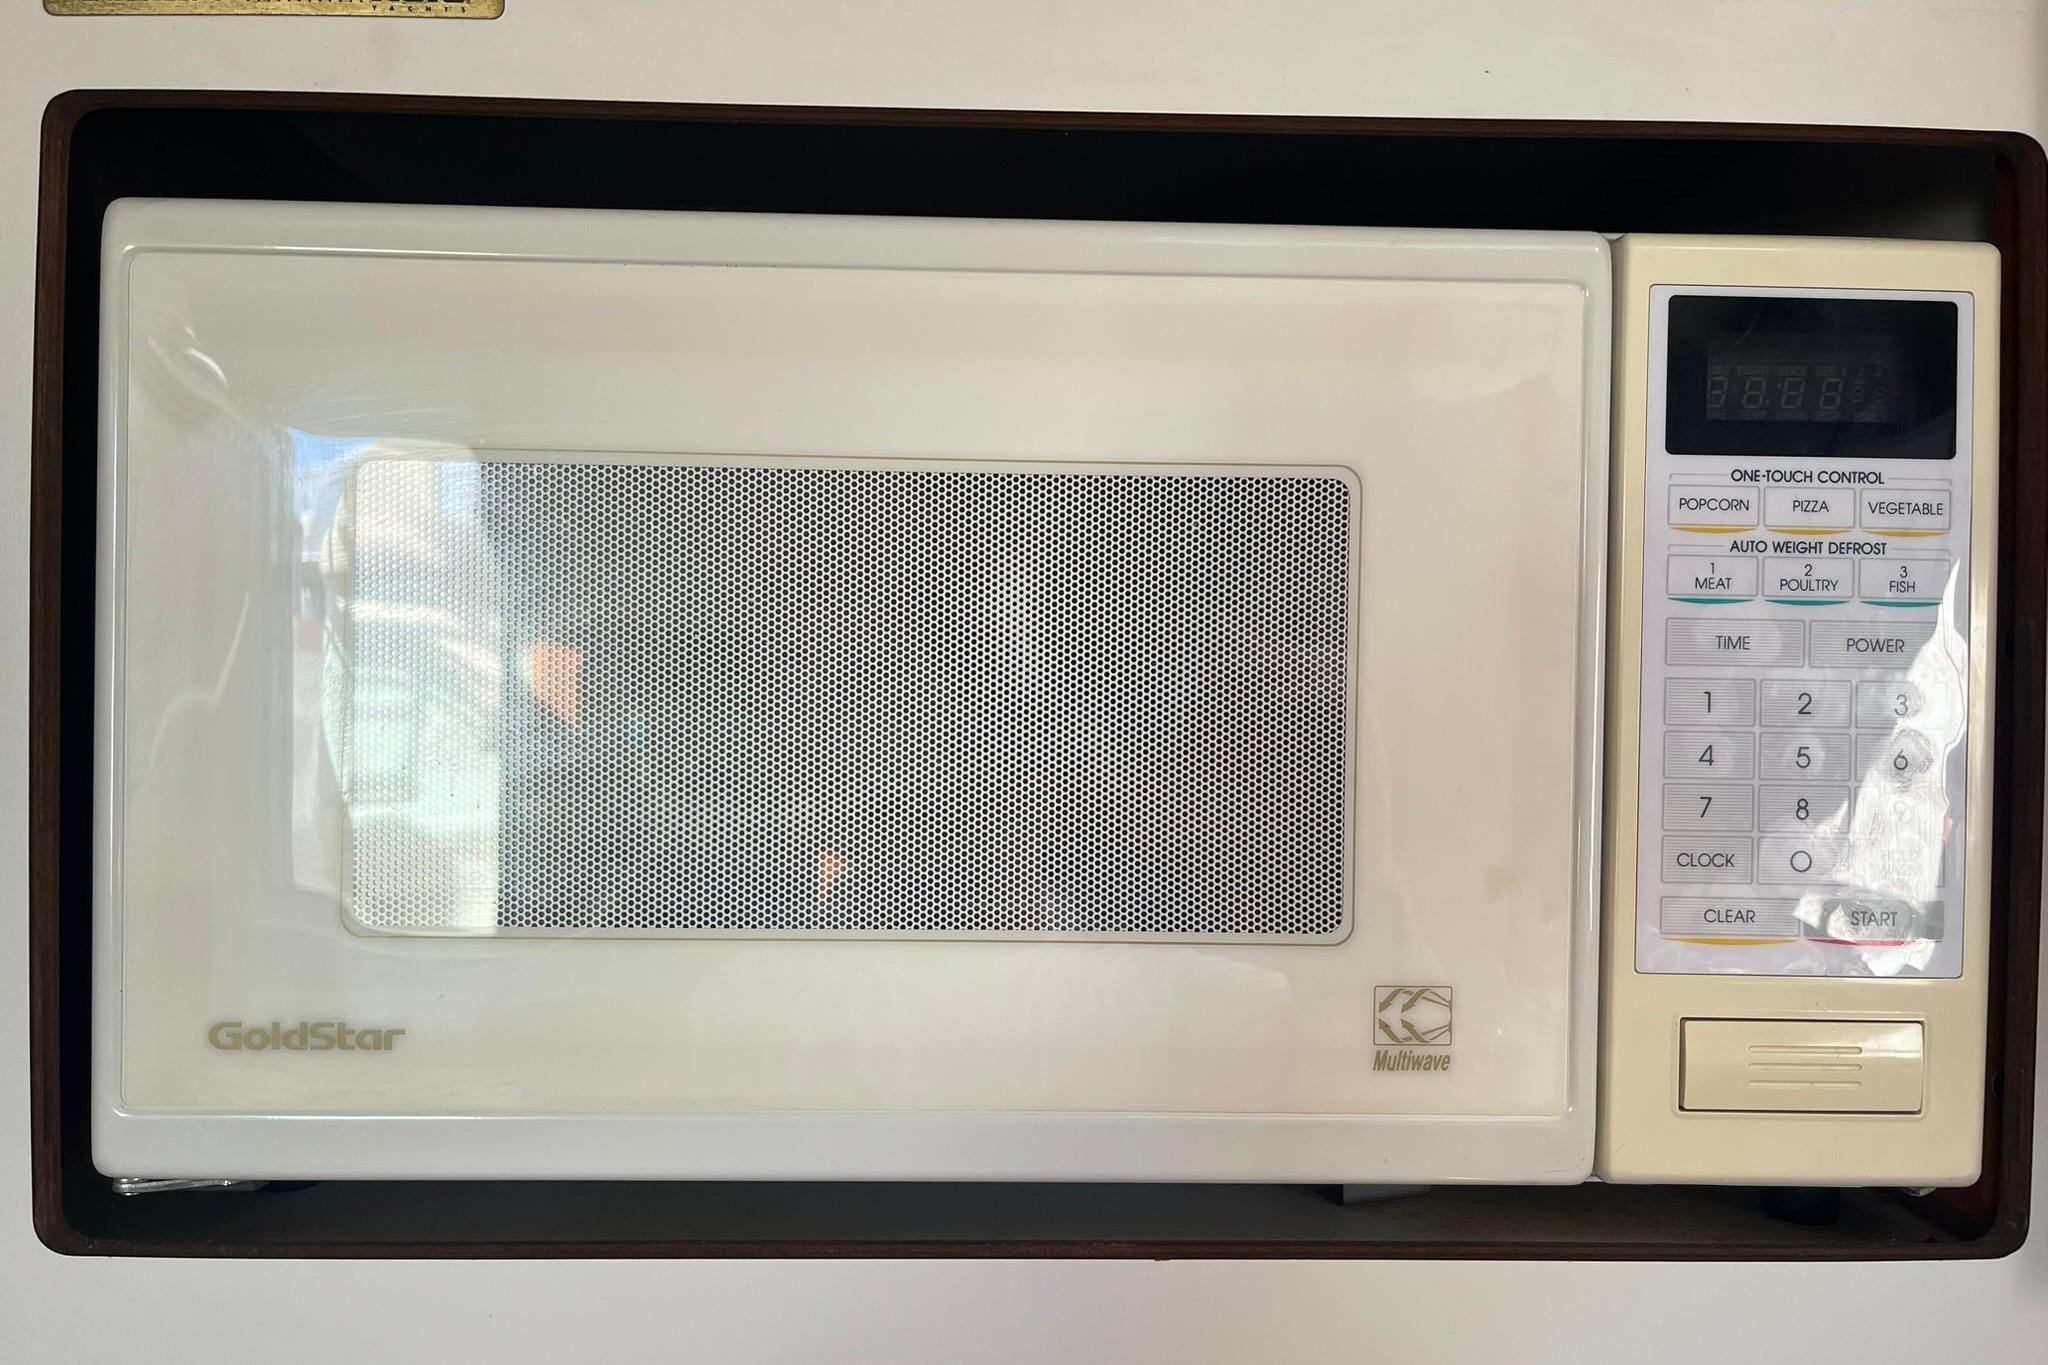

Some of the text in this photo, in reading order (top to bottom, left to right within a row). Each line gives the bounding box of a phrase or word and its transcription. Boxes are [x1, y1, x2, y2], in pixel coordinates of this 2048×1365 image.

[371, 4, 467, 14] YACHTS
[1731, 469, 1885, 484] ONE-TOUCH CONTROL
[1679, 498, 1750, 511] POPCORN
[1792, 500, 1830, 513] PIZZA
[1868, 501, 1944, 516] VEGETABLE
[1729, 541, 1887, 556] AUTO WEIGHT DEFROST
[1709, 562, 1716, 575] 1
[1804, 564, 1813, 577] 2
[1899, 566, 1908, 579] 3
[1695, 577, 1732, 590] MEAT
[1779, 579, 1839, 592] POULTRY
[1889, 581, 1916, 593] FISH
[1716, 635, 1750, 650] TIME
[1846, 638, 1905, 653] POWER
[1704, 691, 1712, 713] 1
[1798, 692, 1812, 715] 2
[1894, 694, 1909, 716] 3
[1698, 744, 1715, 766] 4
[1795, 746, 1811, 769] 5
[1893, 747, 1908, 770] 6
[1700, 796, 1713, 818] 7
[1795, 798, 1809, 820] 8
[1676, 852, 1735, 868] CLOCK
[1703, 908, 1756, 924] CLEAR
[1850, 911, 1898, 927] START
[207, 1021, 406, 1051] GoldStar
[1372, 1049, 1451, 1072] Multiwave
